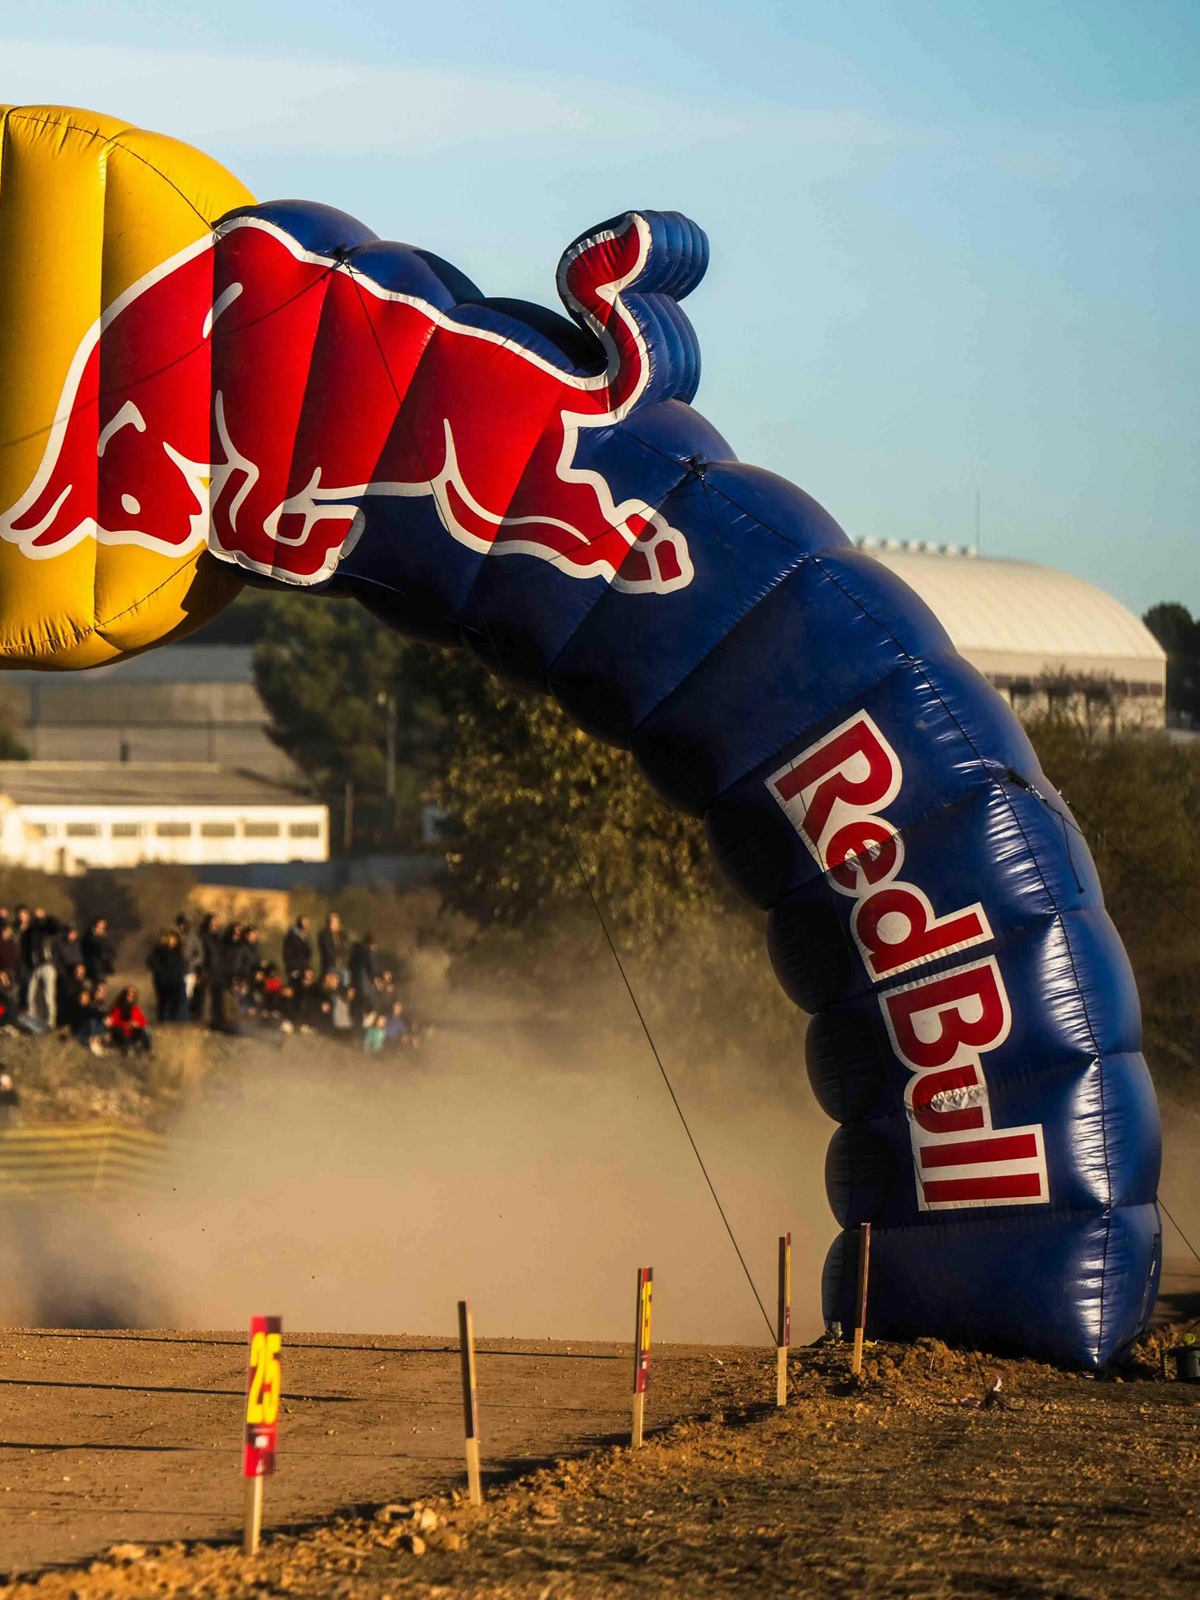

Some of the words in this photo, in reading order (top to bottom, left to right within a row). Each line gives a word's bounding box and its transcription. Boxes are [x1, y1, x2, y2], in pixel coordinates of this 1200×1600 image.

[768, 712, 990, 978] Red
[881, 958, 1047, 1207] Bull
[247, 1332, 282, 1424] 25
